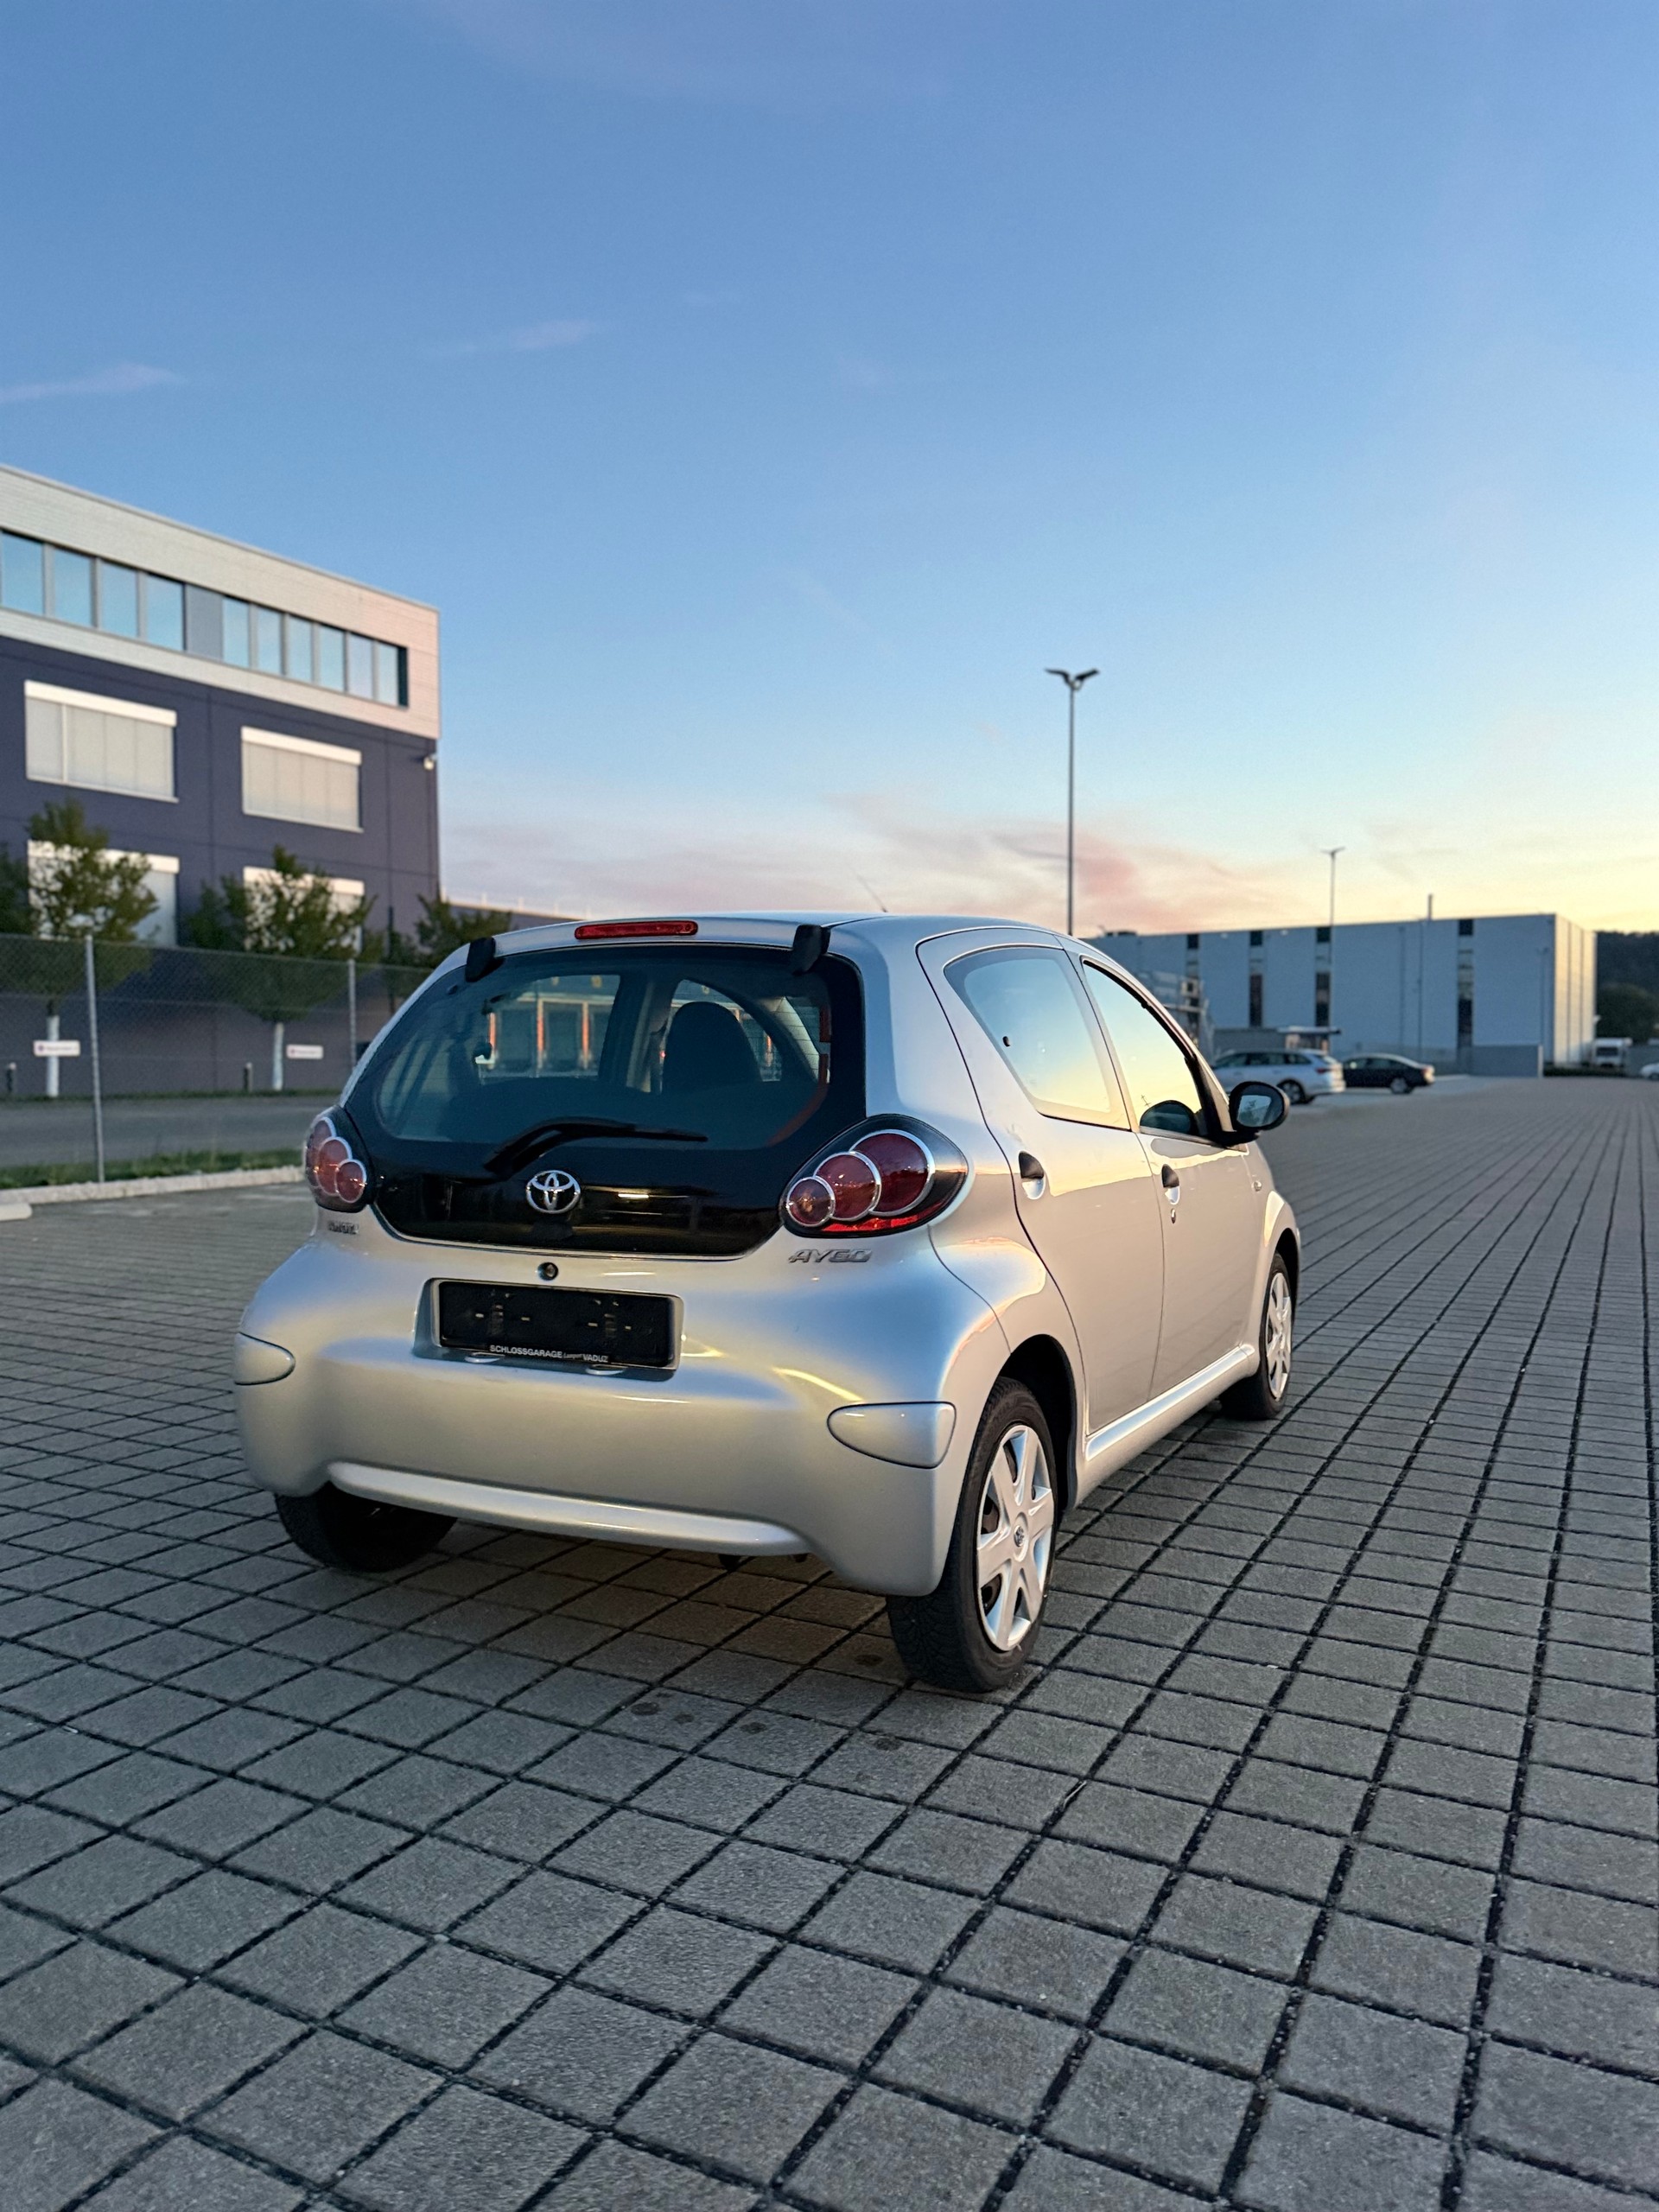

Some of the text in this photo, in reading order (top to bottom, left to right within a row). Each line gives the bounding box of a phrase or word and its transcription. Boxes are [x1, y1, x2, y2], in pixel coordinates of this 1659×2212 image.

[788, 1249, 872, 1263] AYGO
[489, 1344, 563, 1358] SCHLOSSGARAGE
[583, 1353, 609, 1363] VADUZ
